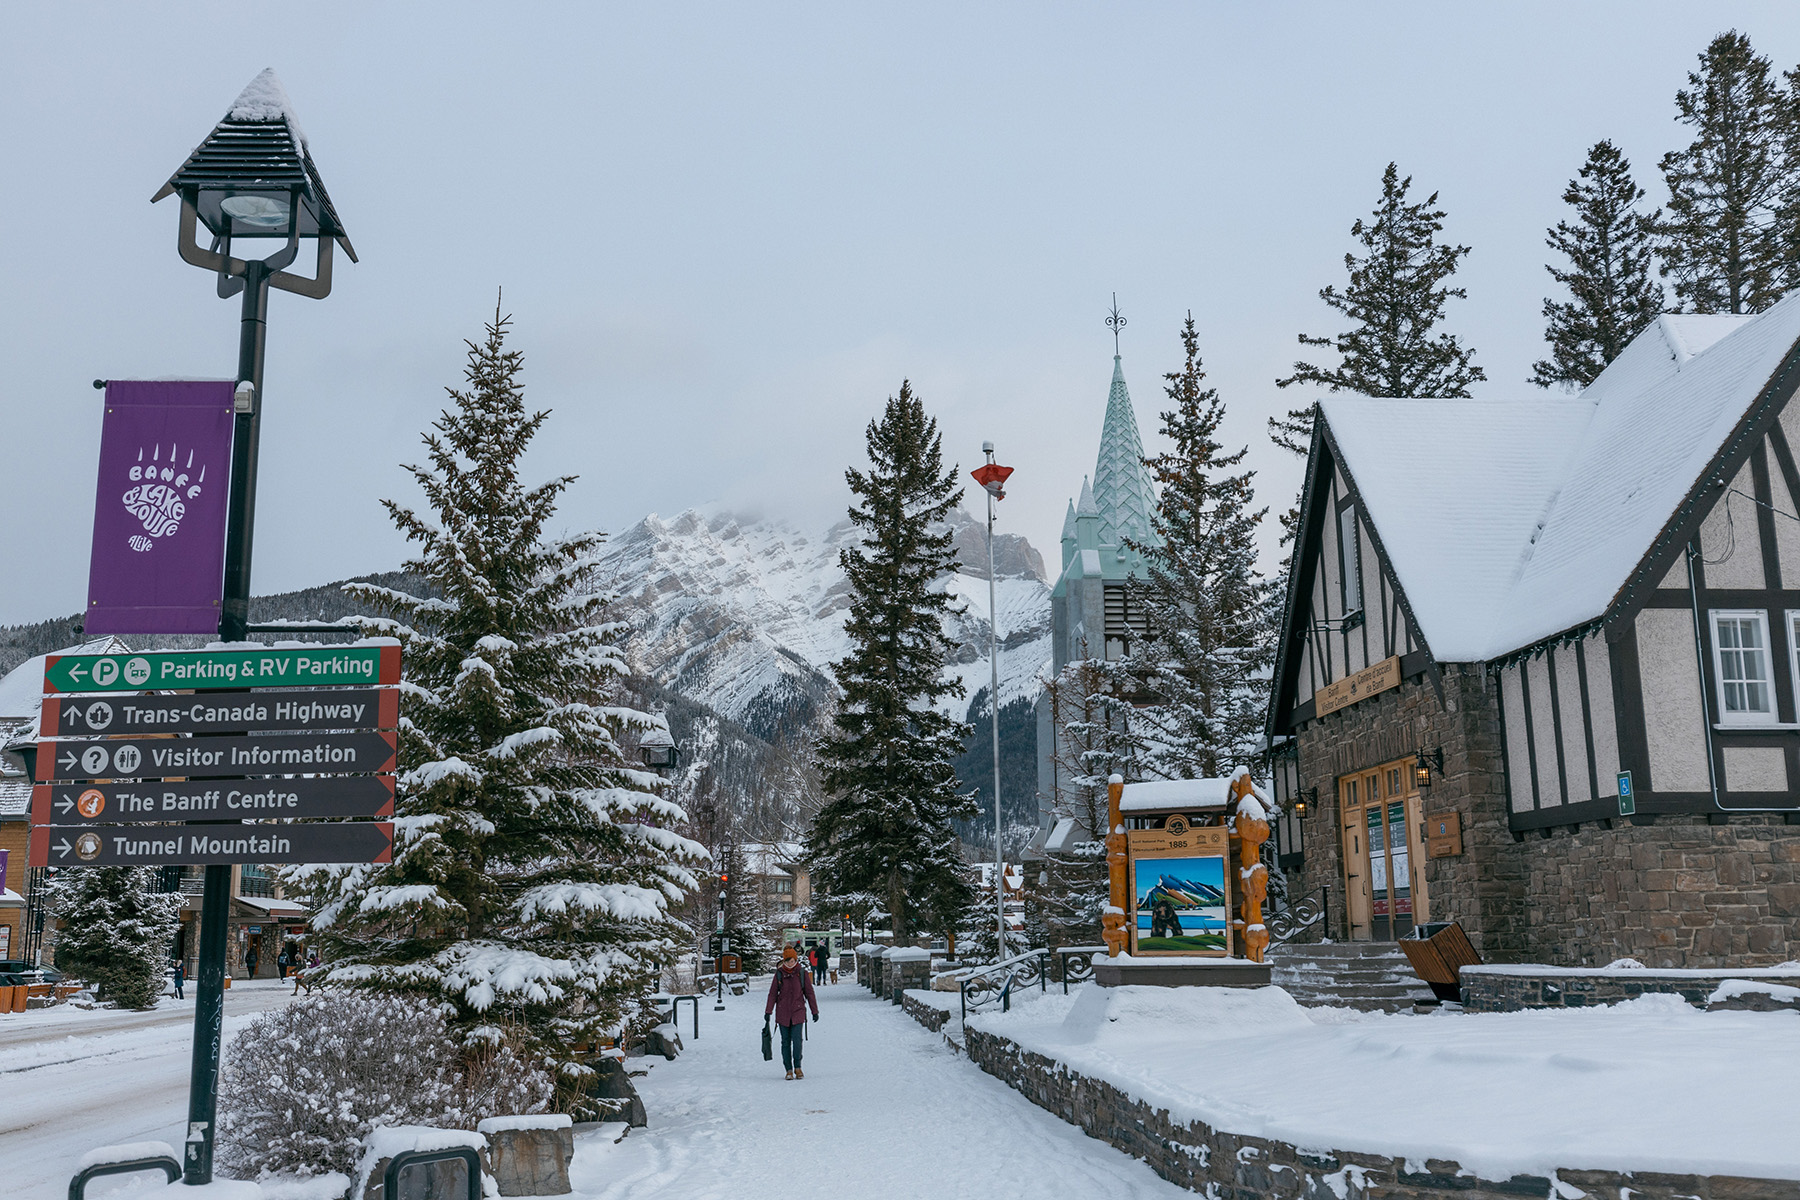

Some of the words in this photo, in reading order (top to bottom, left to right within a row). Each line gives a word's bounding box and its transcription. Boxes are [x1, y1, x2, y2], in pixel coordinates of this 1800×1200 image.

[129, 465, 202, 499] BANFF
[122, 486, 141, 505] &
[161, 660, 237, 681] Parking
[241, 660, 255, 677] &
[260, 658, 290, 676] RV
[296, 656, 374, 677] Parking
[1357, 671, 1372, 685] Centre
[1328, 684, 1340, 698] Banff
[1366, 683, 1372, 694] de
[1372, 676, 1385, 692] Banff
[123, 702, 268, 725] Trans-Canada
[275, 700, 366, 724] Highway
[1321, 699, 1334, 713] Visitor
[1335, 694, 1349, 707] Centre
[152, 747, 223, 767] Visitor
[231, 743, 357, 766] Information
[116, 793, 155, 812] The
[162, 790, 220, 811] Banff
[227, 789, 299, 809] Centre
[113, 836, 183, 856] Tunnel
[190, 834, 291, 855] Mountain
